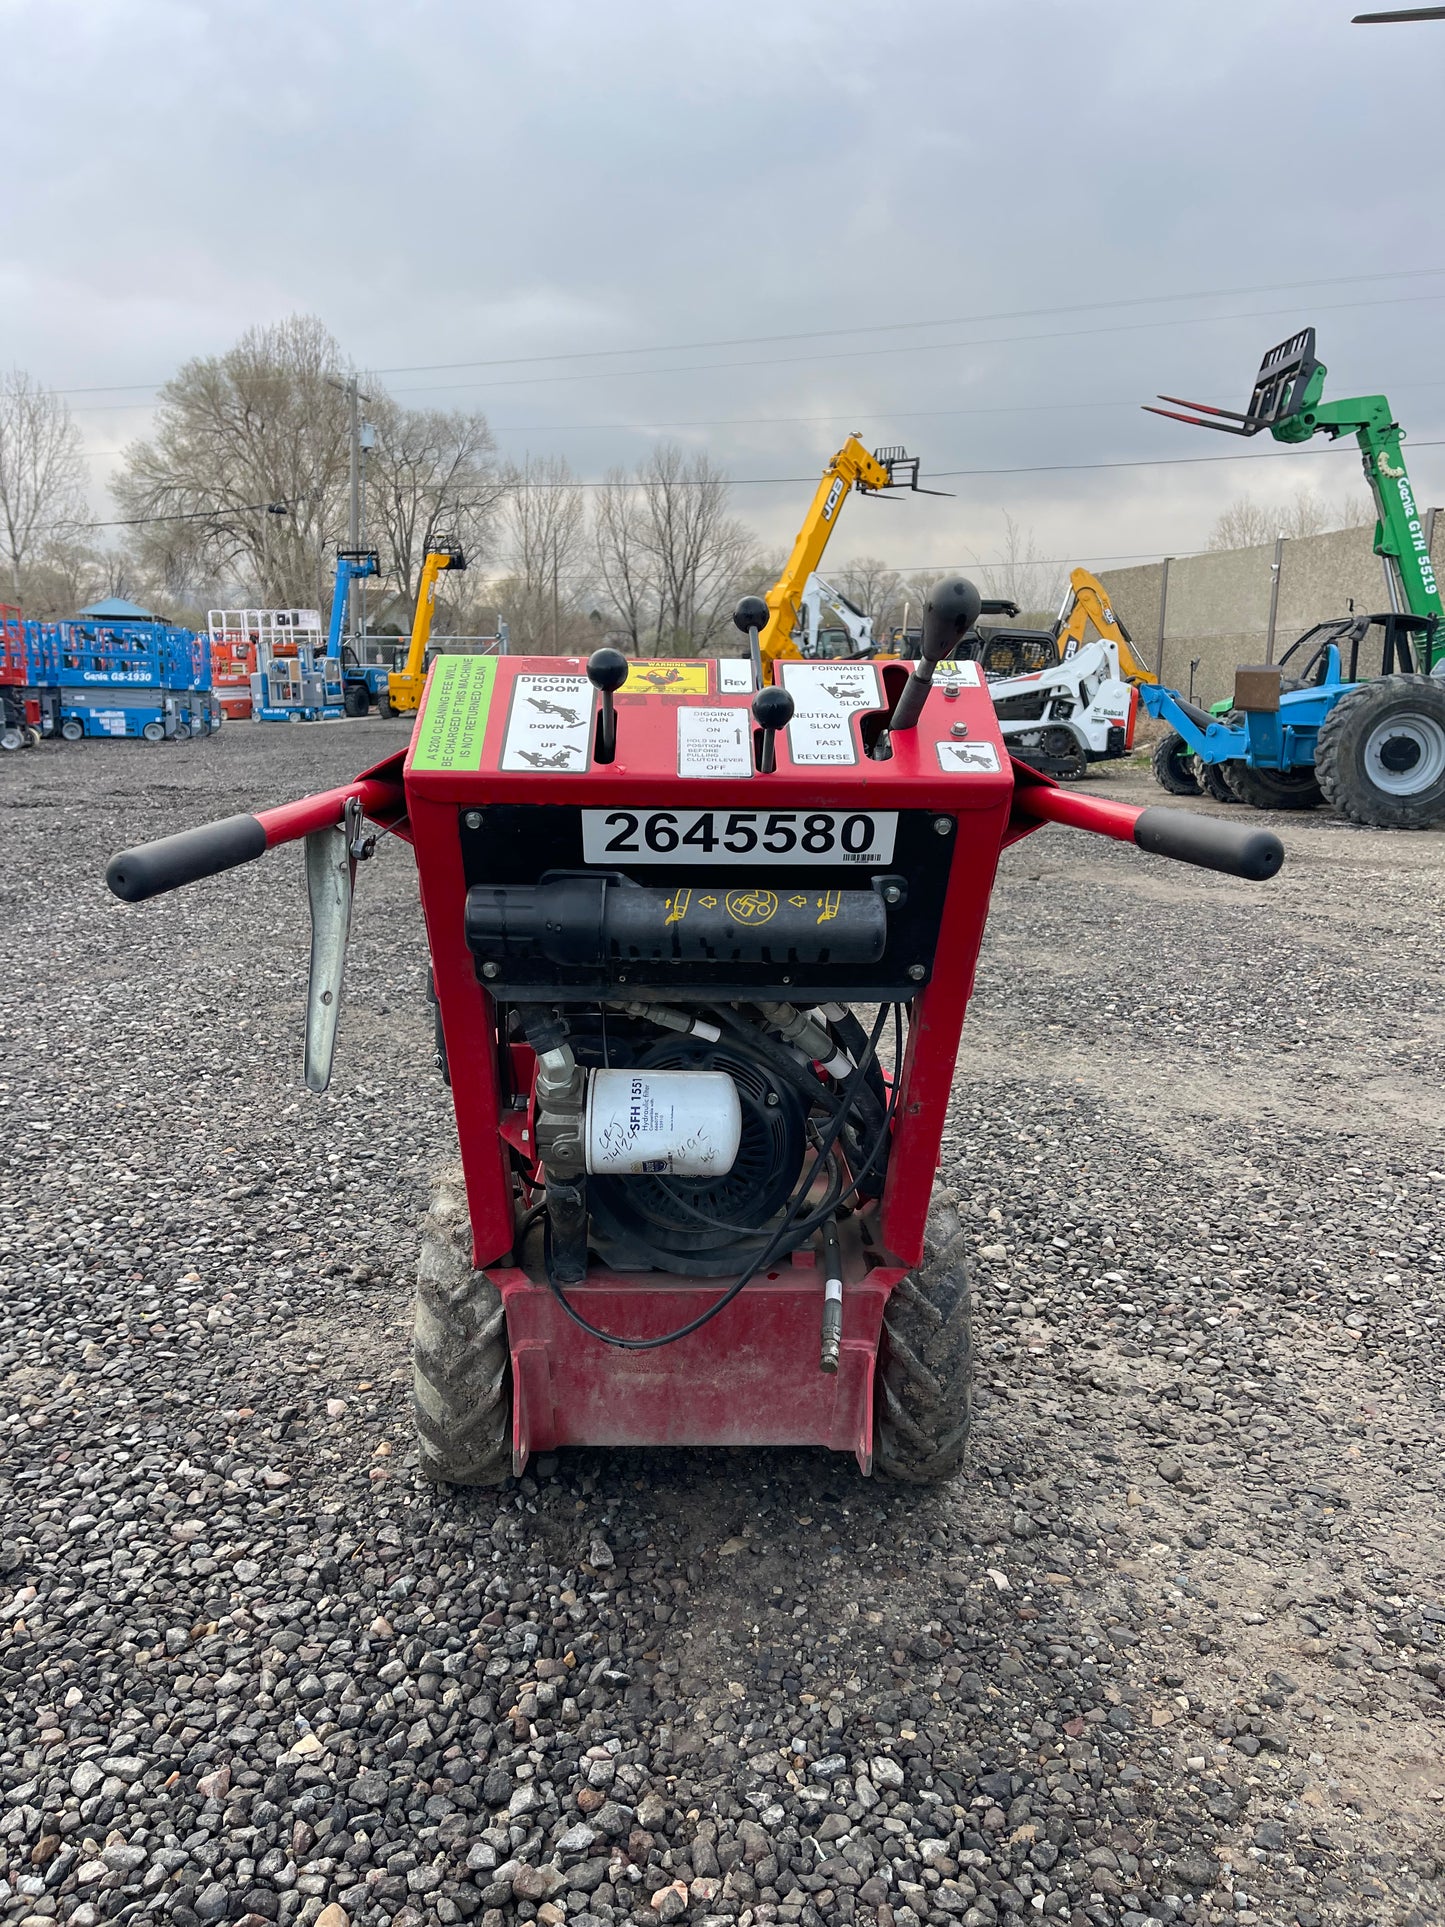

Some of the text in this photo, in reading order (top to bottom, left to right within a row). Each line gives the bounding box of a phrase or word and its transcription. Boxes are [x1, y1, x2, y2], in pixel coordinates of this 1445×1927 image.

[824, 478, 843, 519] JCB
[1397, 477, 1437, 594] Genie GTH 5519
[1064, 640, 1077, 662] CB
[83, 671, 152, 681] Genie GS-1930
[445, 663, 457, 680] WILL
[458, 658, 473, 689] MACHINE
[442, 681, 453, 695] FEE
[454, 690, 467, 707] THIS
[433, 696, 450, 734] CLEANING
[459, 666, 487, 758] IS NOT RETURNED CLEAN
[428, 735, 441, 753] $200
[444, 716, 461, 755] CHARGED
[441, 756, 453, 767] BE
[604, 812, 875, 854] 2645580
[630, 1078, 642, 1131] SFH 1551
[642, 1099, 650, 1131] Hydraulic
